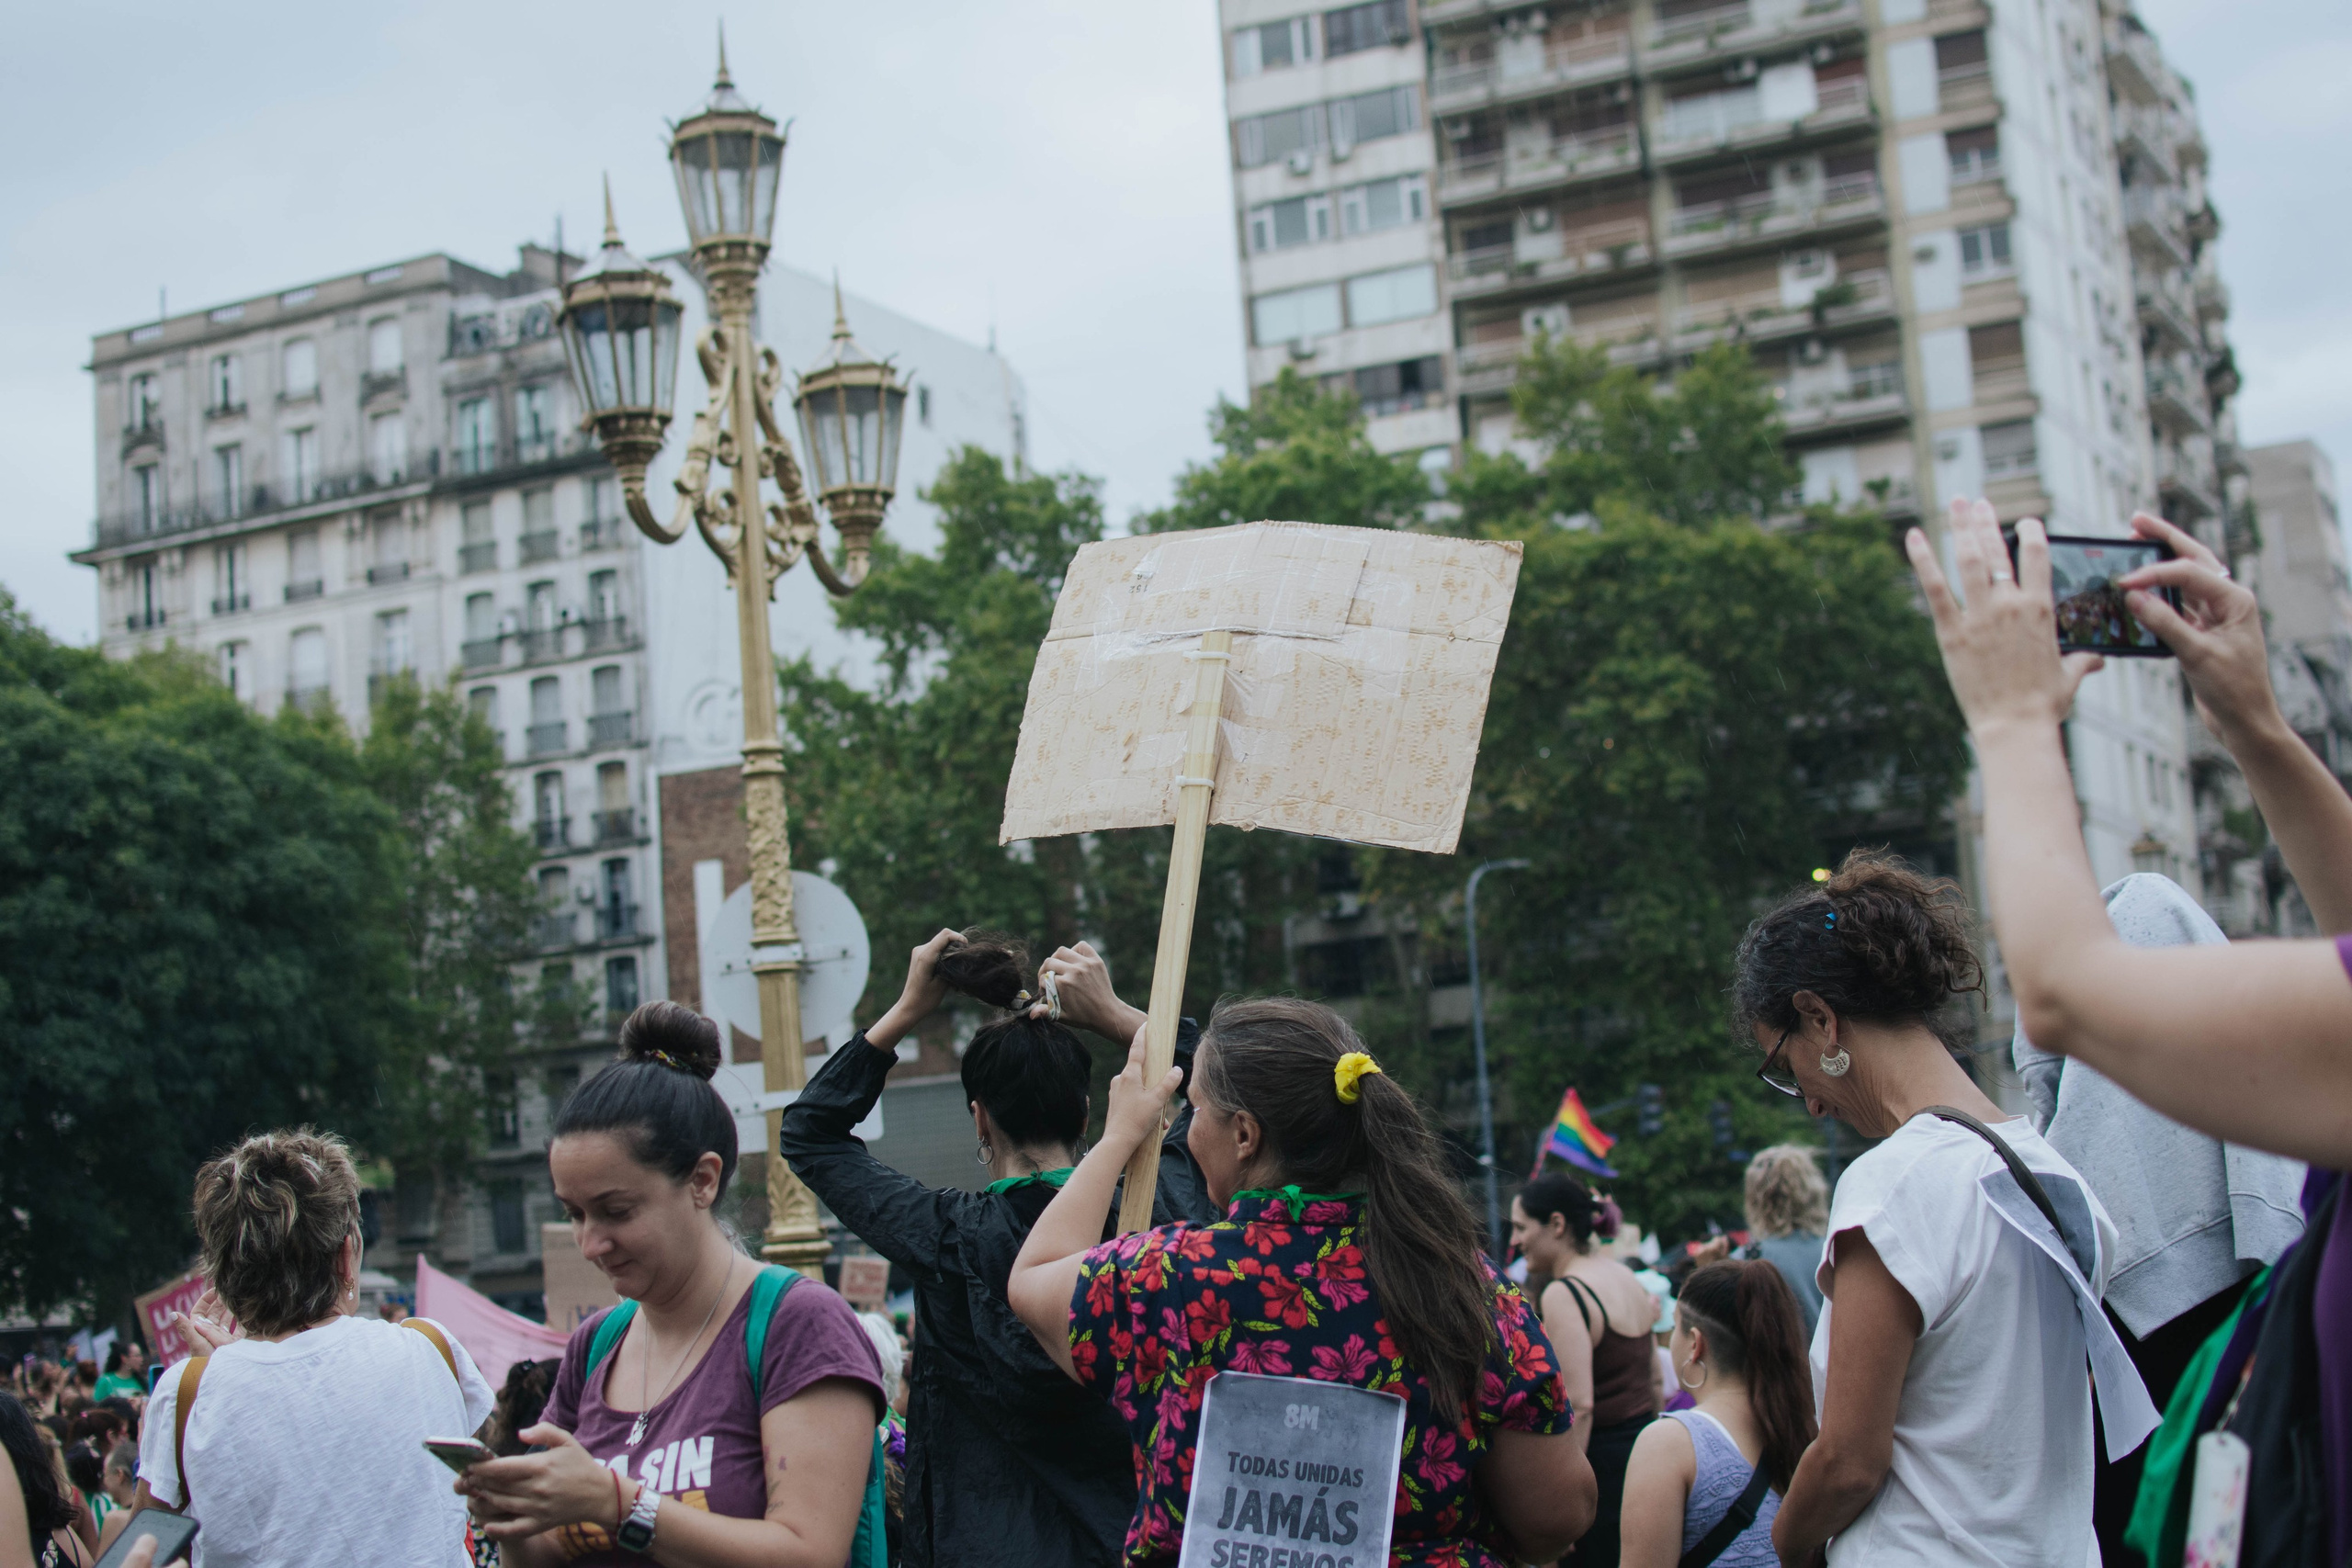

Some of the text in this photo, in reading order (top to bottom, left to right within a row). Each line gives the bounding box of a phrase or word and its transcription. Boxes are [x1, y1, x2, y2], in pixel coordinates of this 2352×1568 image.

[1283, 1404, 1320, 1430] 8M
[636, 1436, 715, 1493] SIN
[1227, 1451, 1363, 1488] TODAS UNIDAS
[1217, 1486, 1359, 1546] JAMÁS
